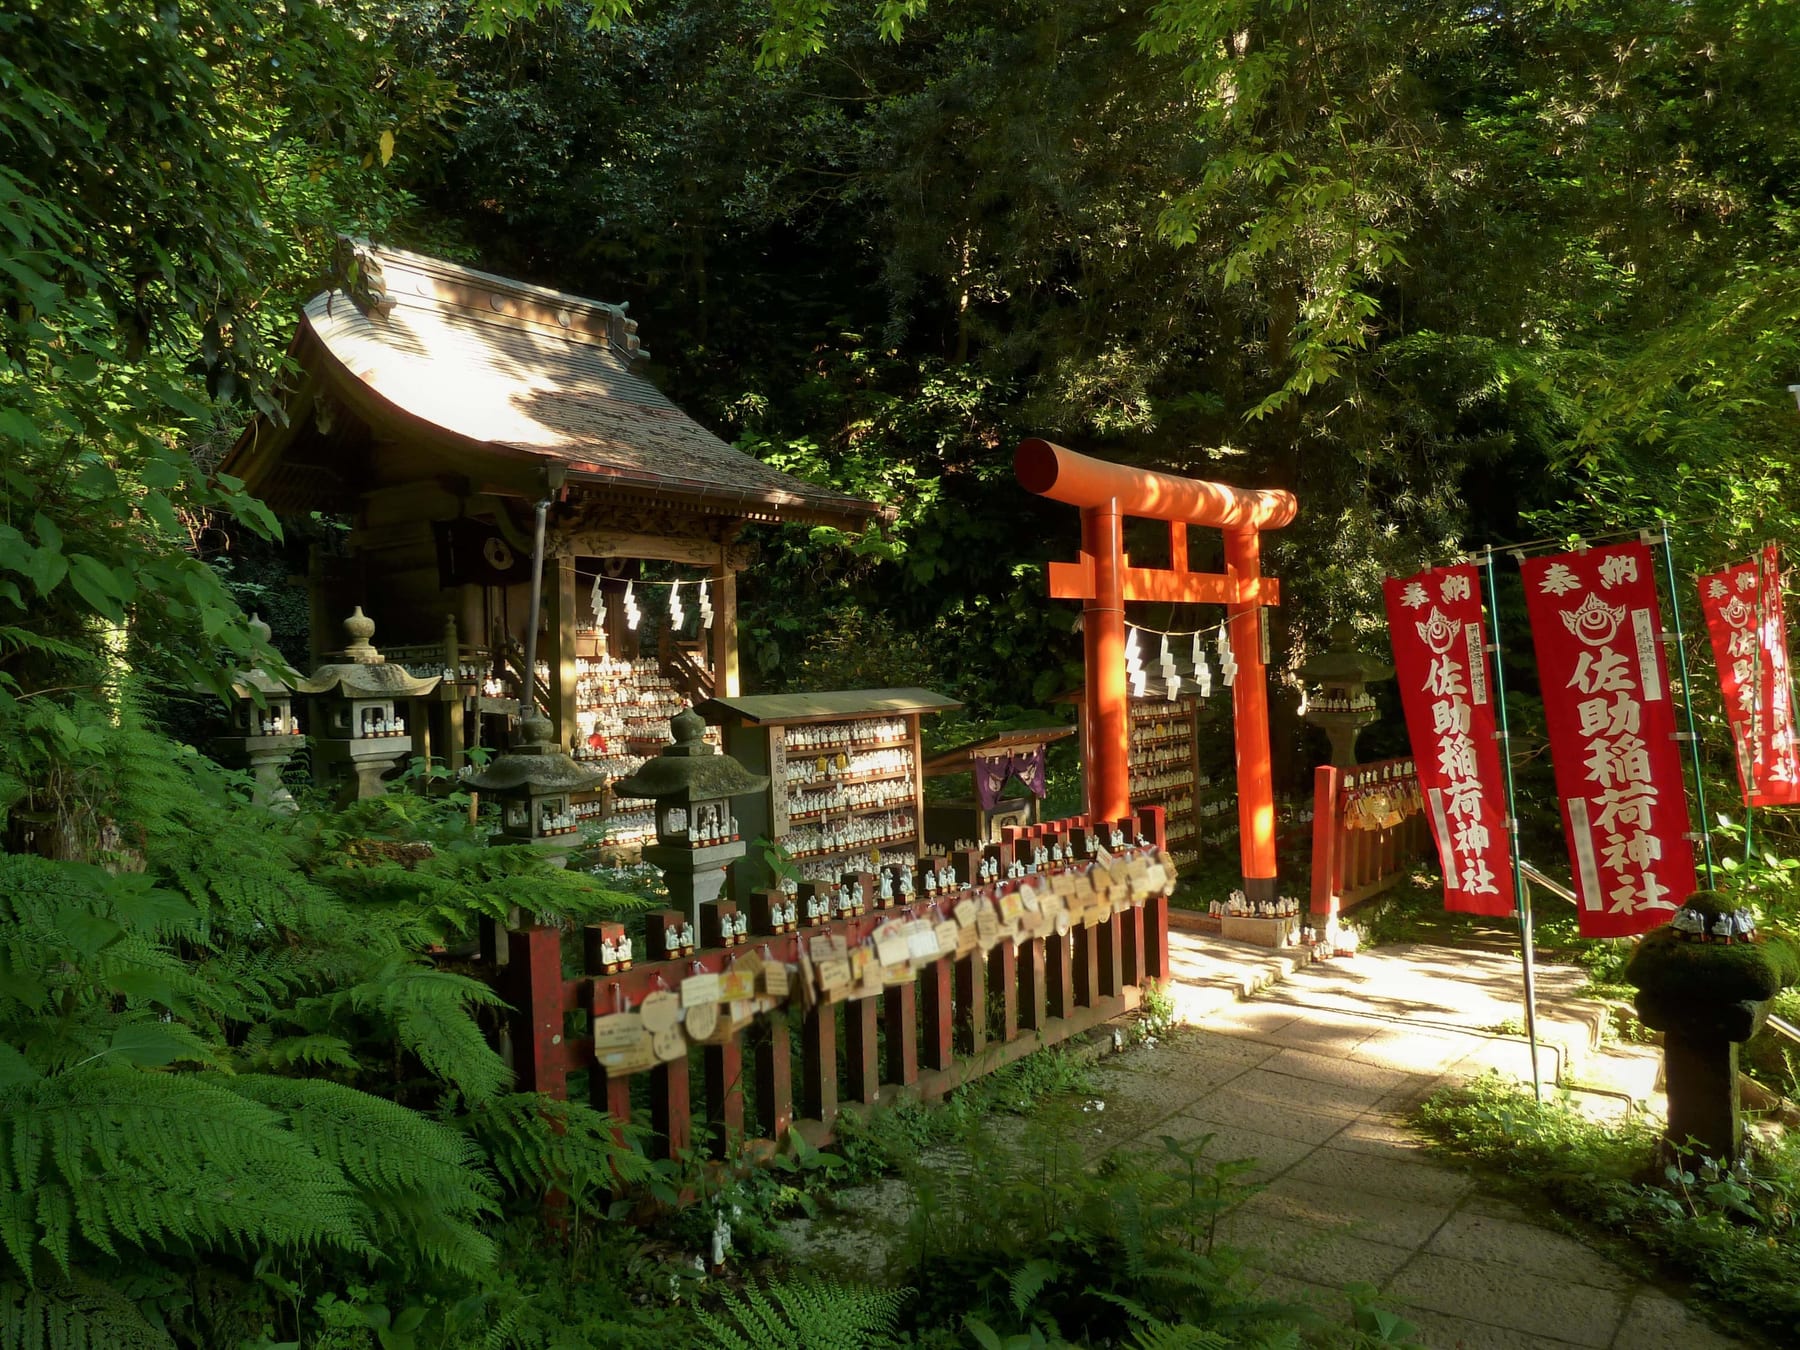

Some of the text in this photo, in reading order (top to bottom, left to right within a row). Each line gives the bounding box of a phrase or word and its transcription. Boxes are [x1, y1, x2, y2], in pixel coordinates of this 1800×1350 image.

[1399, 574, 1471, 610] 奉納
[1538, 554, 1638, 597] 奉納
[1421, 653, 1500, 896] 佐助稲荷神社
[1565, 645, 1679, 916] 佐助稲荷神社
